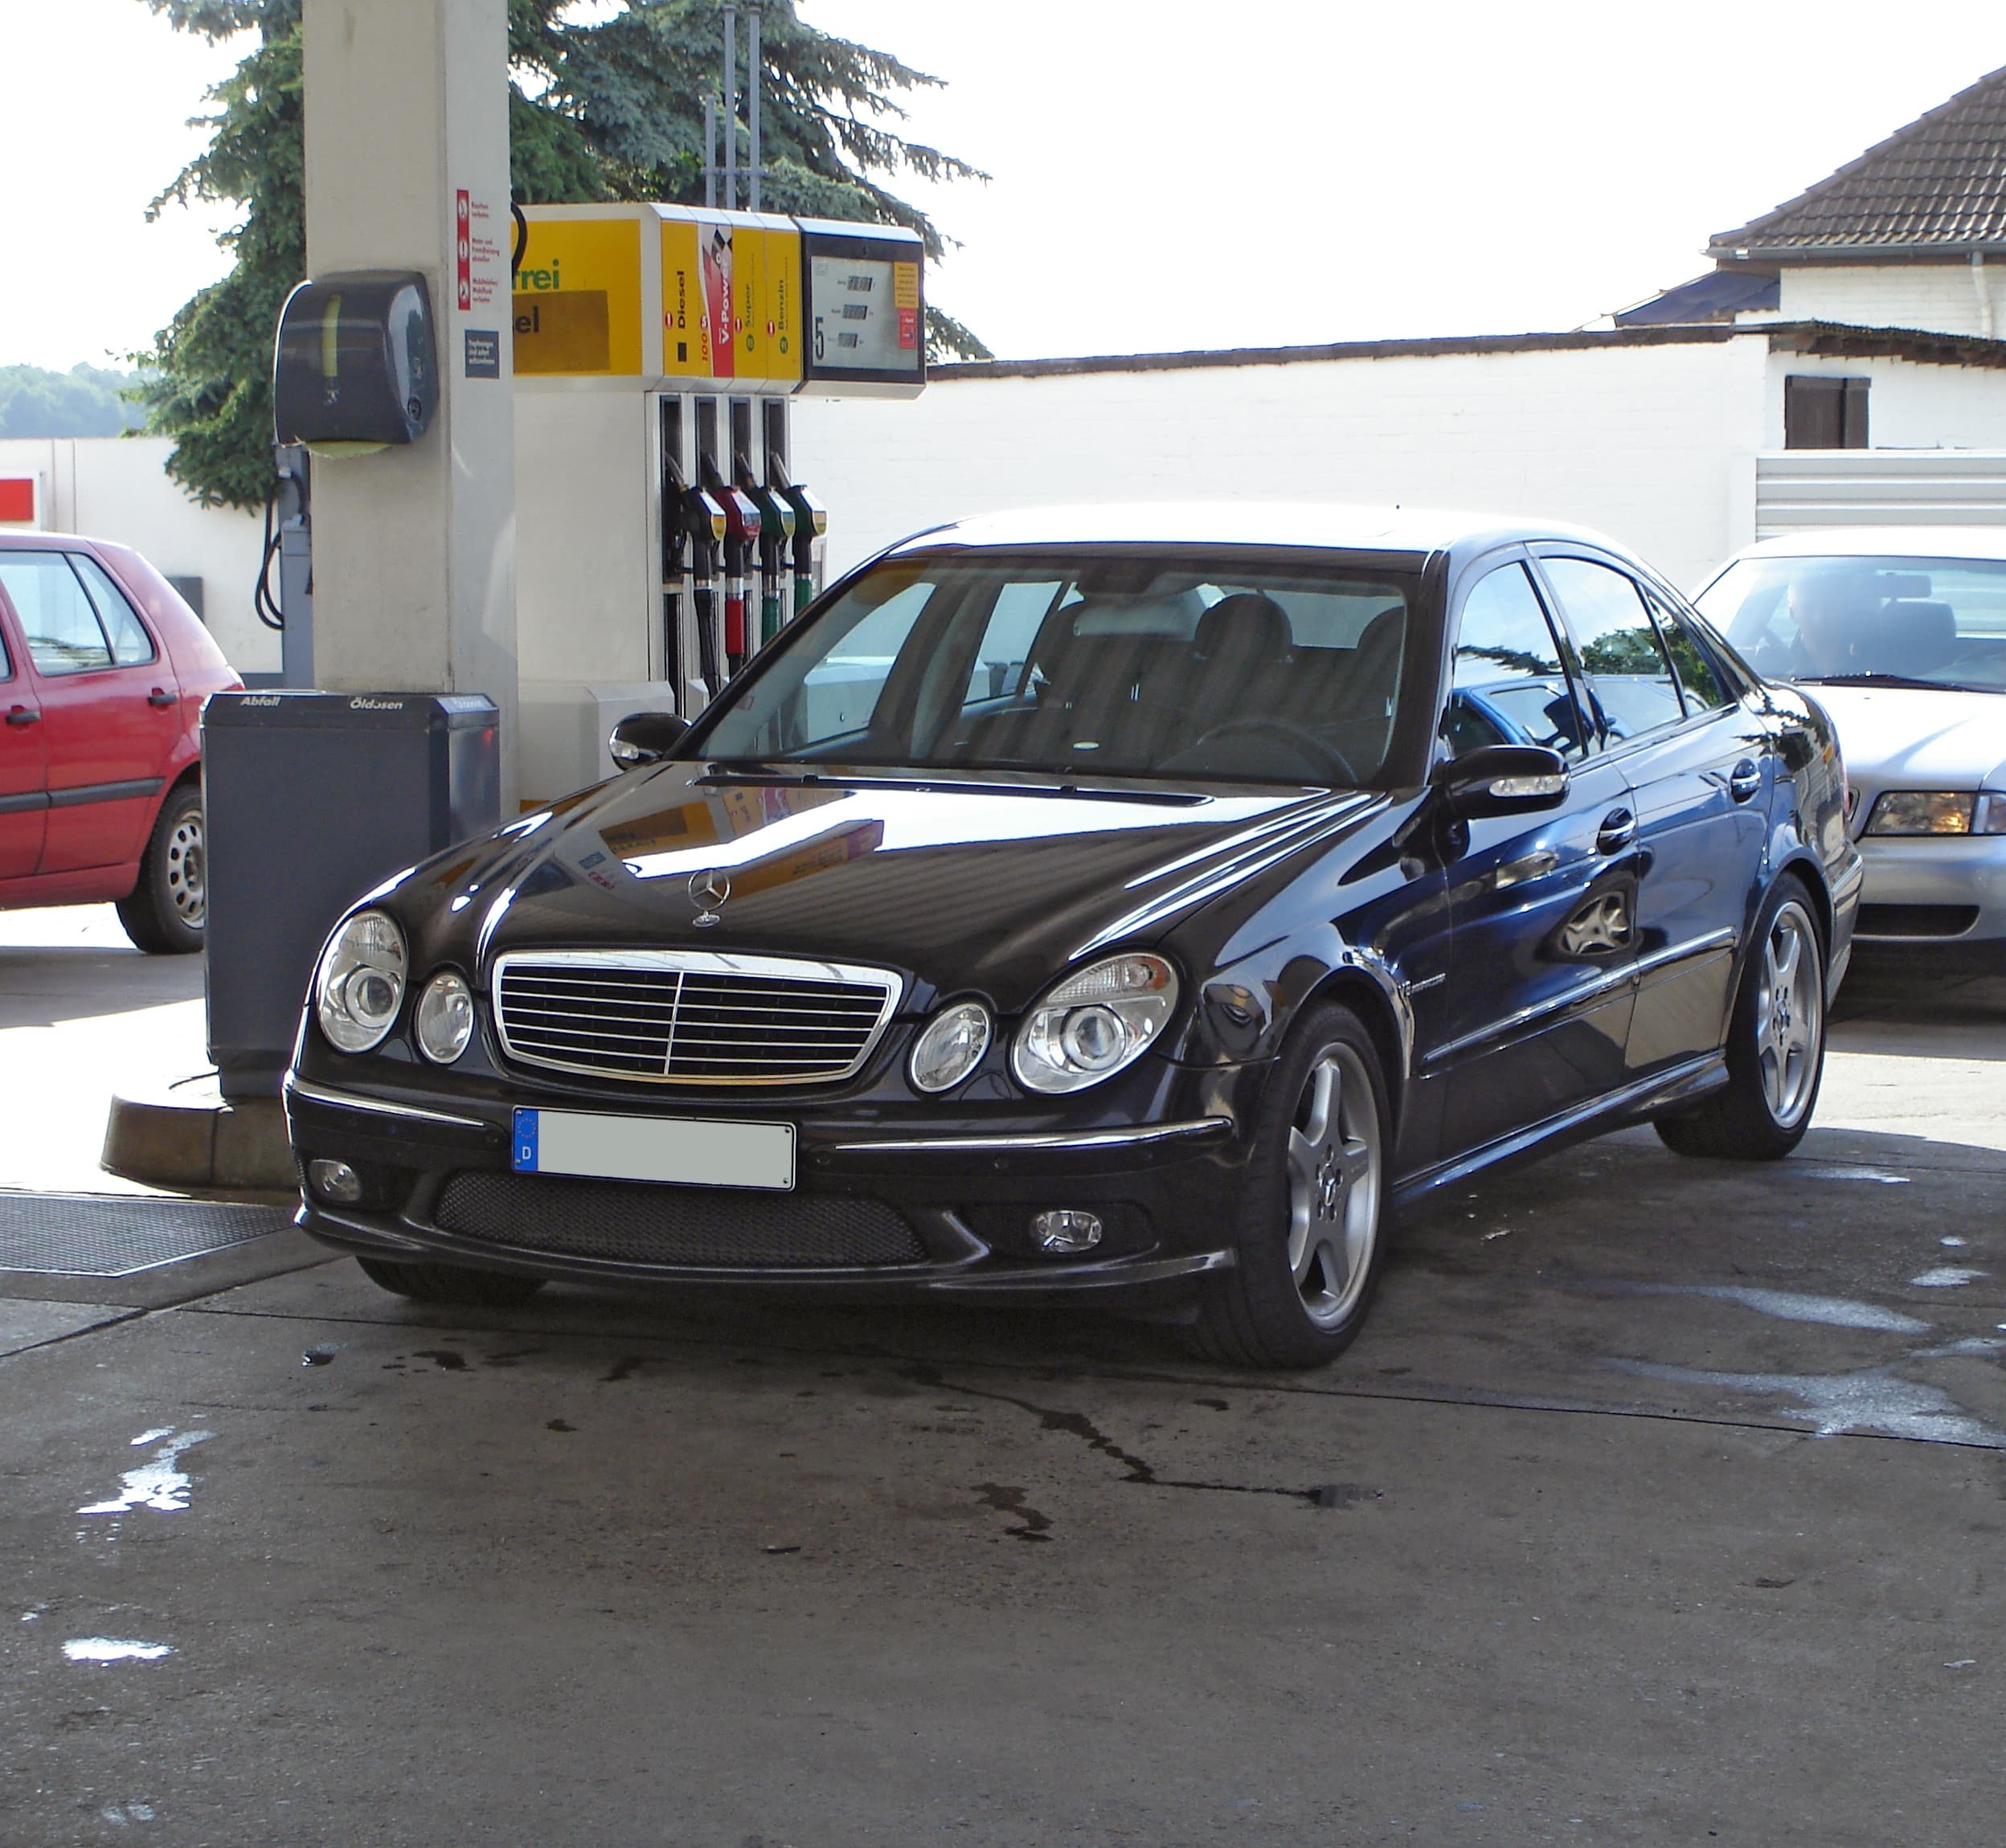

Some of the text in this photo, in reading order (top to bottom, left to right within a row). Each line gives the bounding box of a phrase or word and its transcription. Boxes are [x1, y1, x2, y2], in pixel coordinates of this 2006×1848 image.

[677, 270, 686, 329] Diesel
[815, 317, 825, 361] 5
[240, 696, 281, 706] Abfall
[522, 1146, 531, 1160] D
